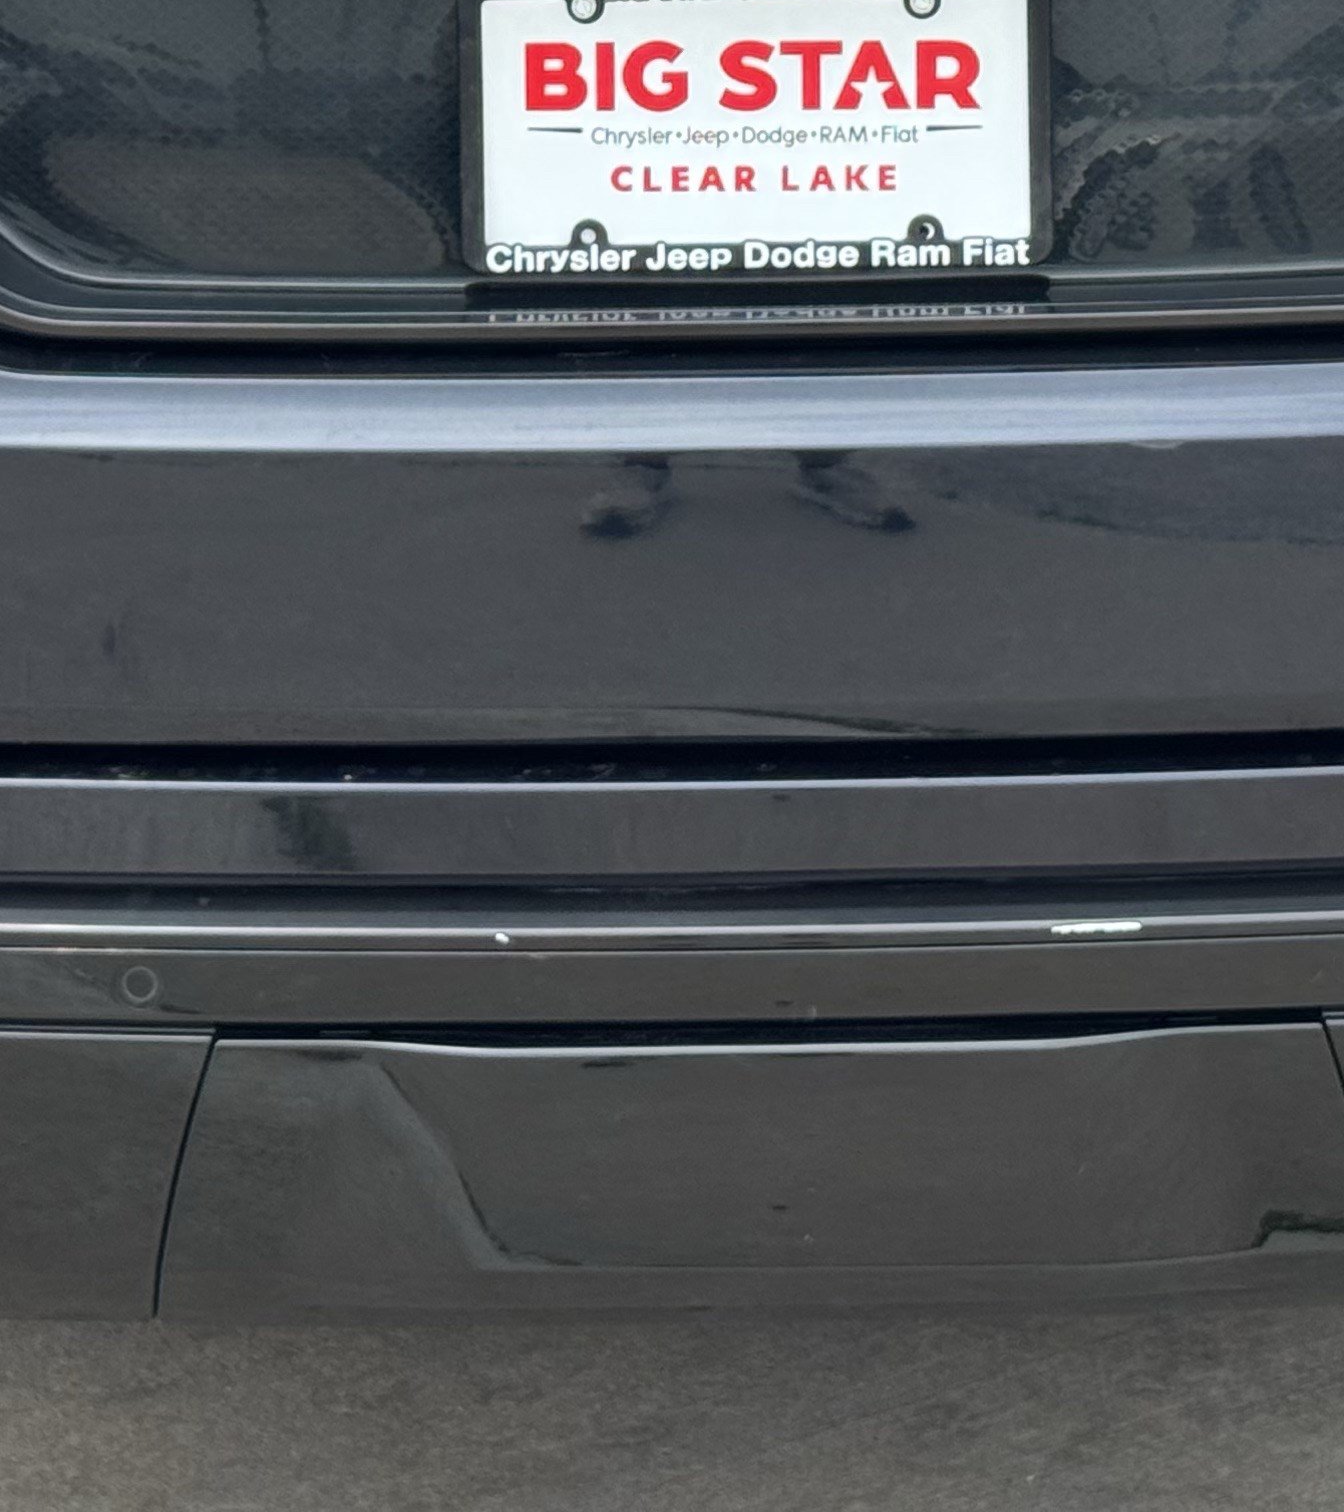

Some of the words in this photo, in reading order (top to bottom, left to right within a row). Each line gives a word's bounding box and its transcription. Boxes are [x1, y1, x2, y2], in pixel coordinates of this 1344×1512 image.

[523, 39, 689, 112] BIG
[718, 39, 982, 111] STAR
[610, 164, 757, 192] CLEAR
[781, 163, 897, 191] LAKE
[485, 243, 637, 274] Chrysler
[645, 241, 733, 271] Jeep
[743, 239, 860, 269] Dodge
[871, 238, 952, 268] Ram
[962, 236, 1032, 267] Fiat
